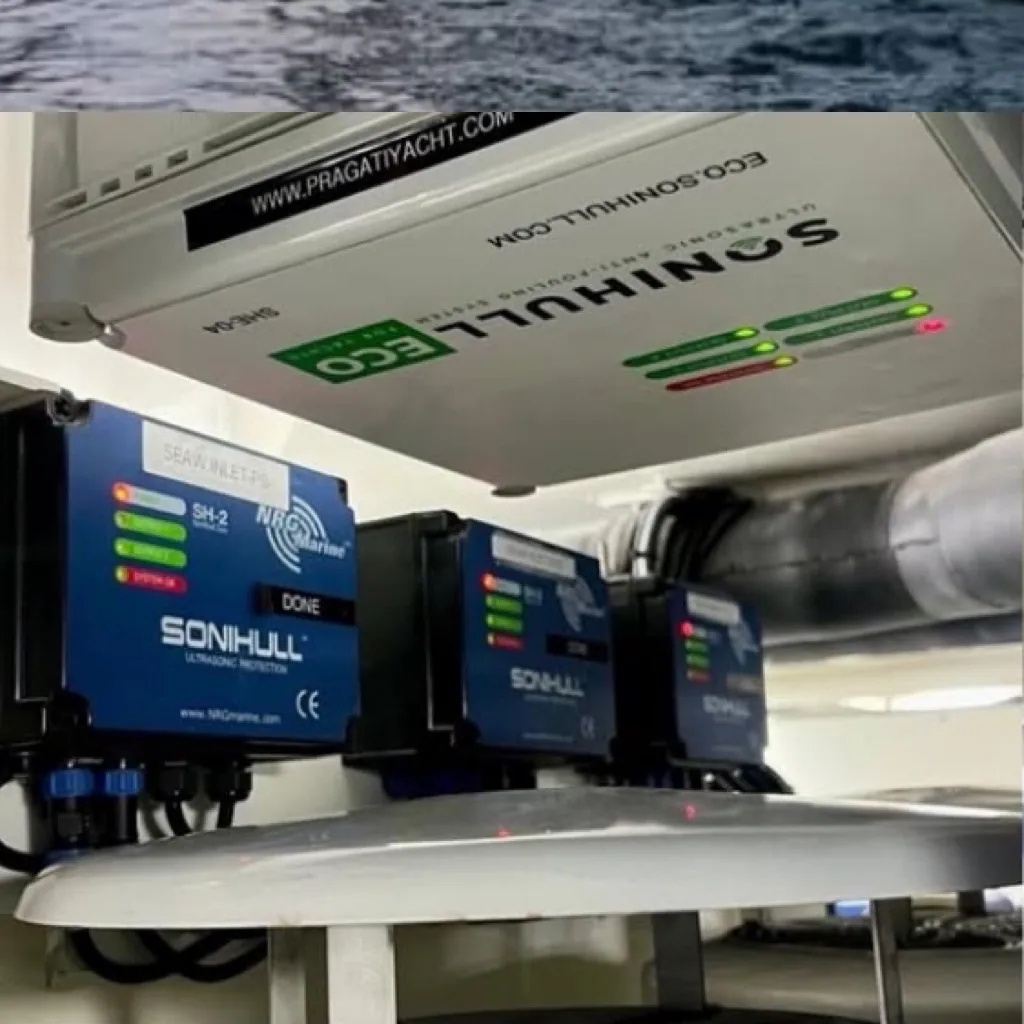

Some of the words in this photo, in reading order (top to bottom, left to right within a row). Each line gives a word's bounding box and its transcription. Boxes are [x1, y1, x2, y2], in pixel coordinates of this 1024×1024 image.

[251, 111, 515, 215] WWW.PRAGATIYACHT.COM
[488, 151, 768, 249] ECO.SONIHULL.COM
[433, 217, 839, 340] SONIHULL
[315, 339, 437, 376] ECO
[192, 501, 229, 526] SH-2
[282, 592, 320, 615] DONE
[160, 614, 303, 662] SONIHULL
